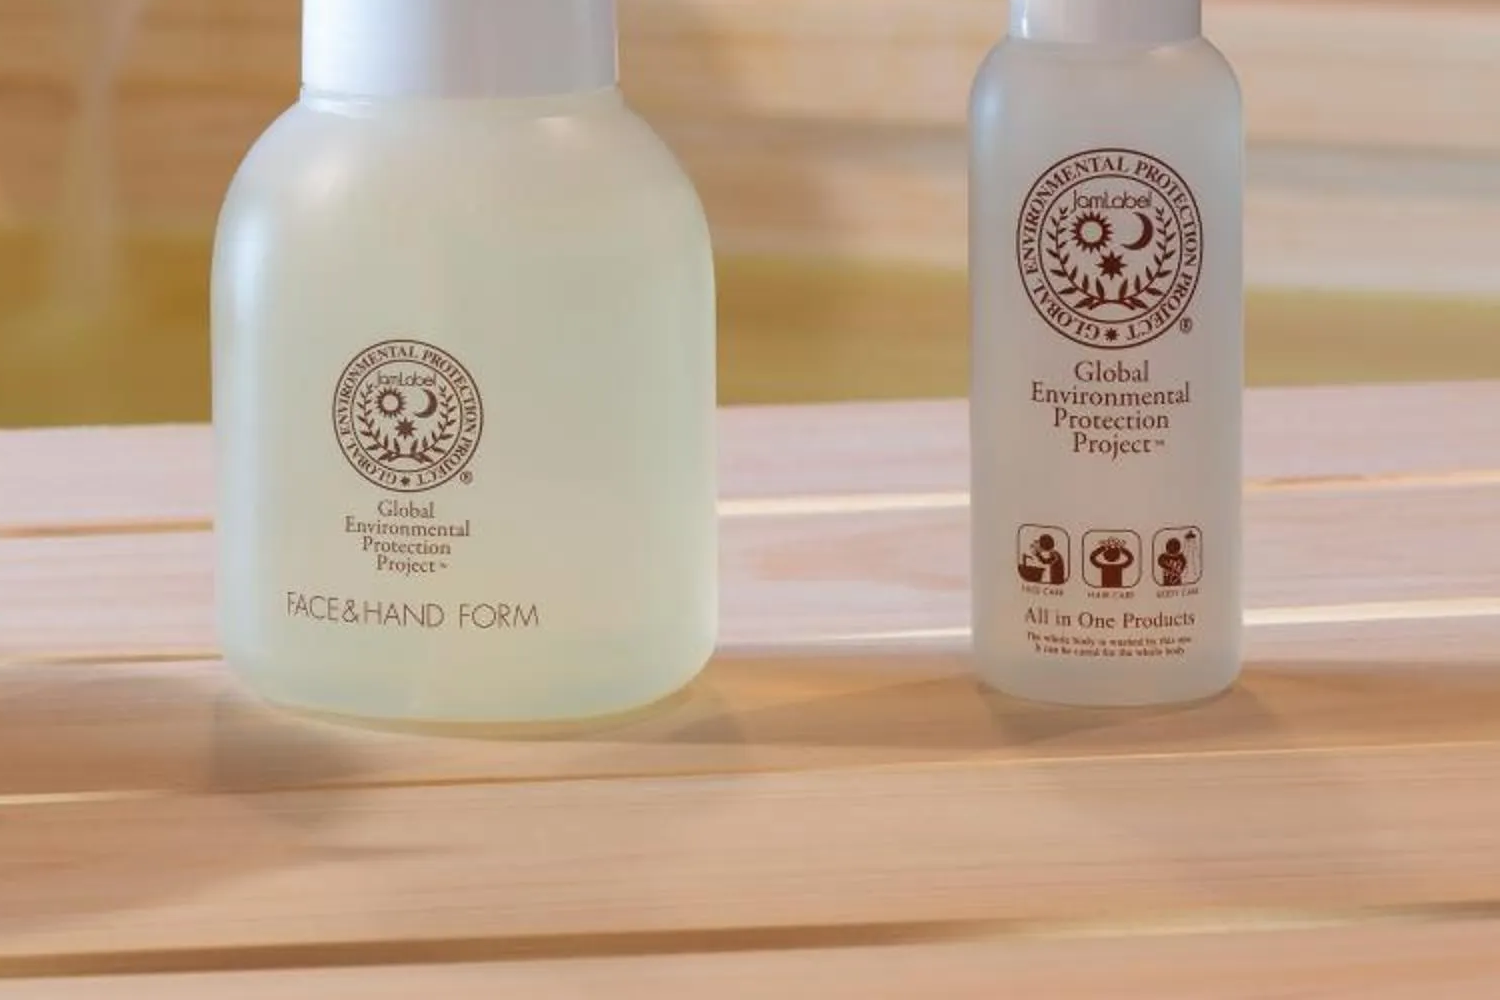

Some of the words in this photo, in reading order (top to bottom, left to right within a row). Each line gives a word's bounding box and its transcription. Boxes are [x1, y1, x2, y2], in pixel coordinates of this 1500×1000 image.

[1022, 157, 1130, 274] ENVIRONMENTAL
[1070, 190, 1152, 213] JamLabel
[1133, 160, 1197, 268] PROTECTION
[1030, 282, 1100, 341] GLOBAL
[1126, 273, 1194, 341] PROJECT
[1073, 360, 1149, 383] Global
[337, 345, 418, 436] ENVIRONMENTAL
[422, 349, 477, 435] PROTECTION
[1031, 381, 1190, 407] Environmental
[1054, 407, 1169, 429] Protection
[346, 441, 398, 485] GLOBAL
[415, 439, 473, 485] PROJECT
[345, 516, 470, 538] Environmental
[377, 501, 435, 519] Global
[362, 536, 451, 555] Protection
[286, 591, 445, 628] FACE&HAND
[458, 603, 539, 628] FORM
[1025, 606, 1049, 624] All
[1055, 611, 1071, 626] in
[1078, 611, 1115, 628] One
[1123, 610, 1195, 629] Products
